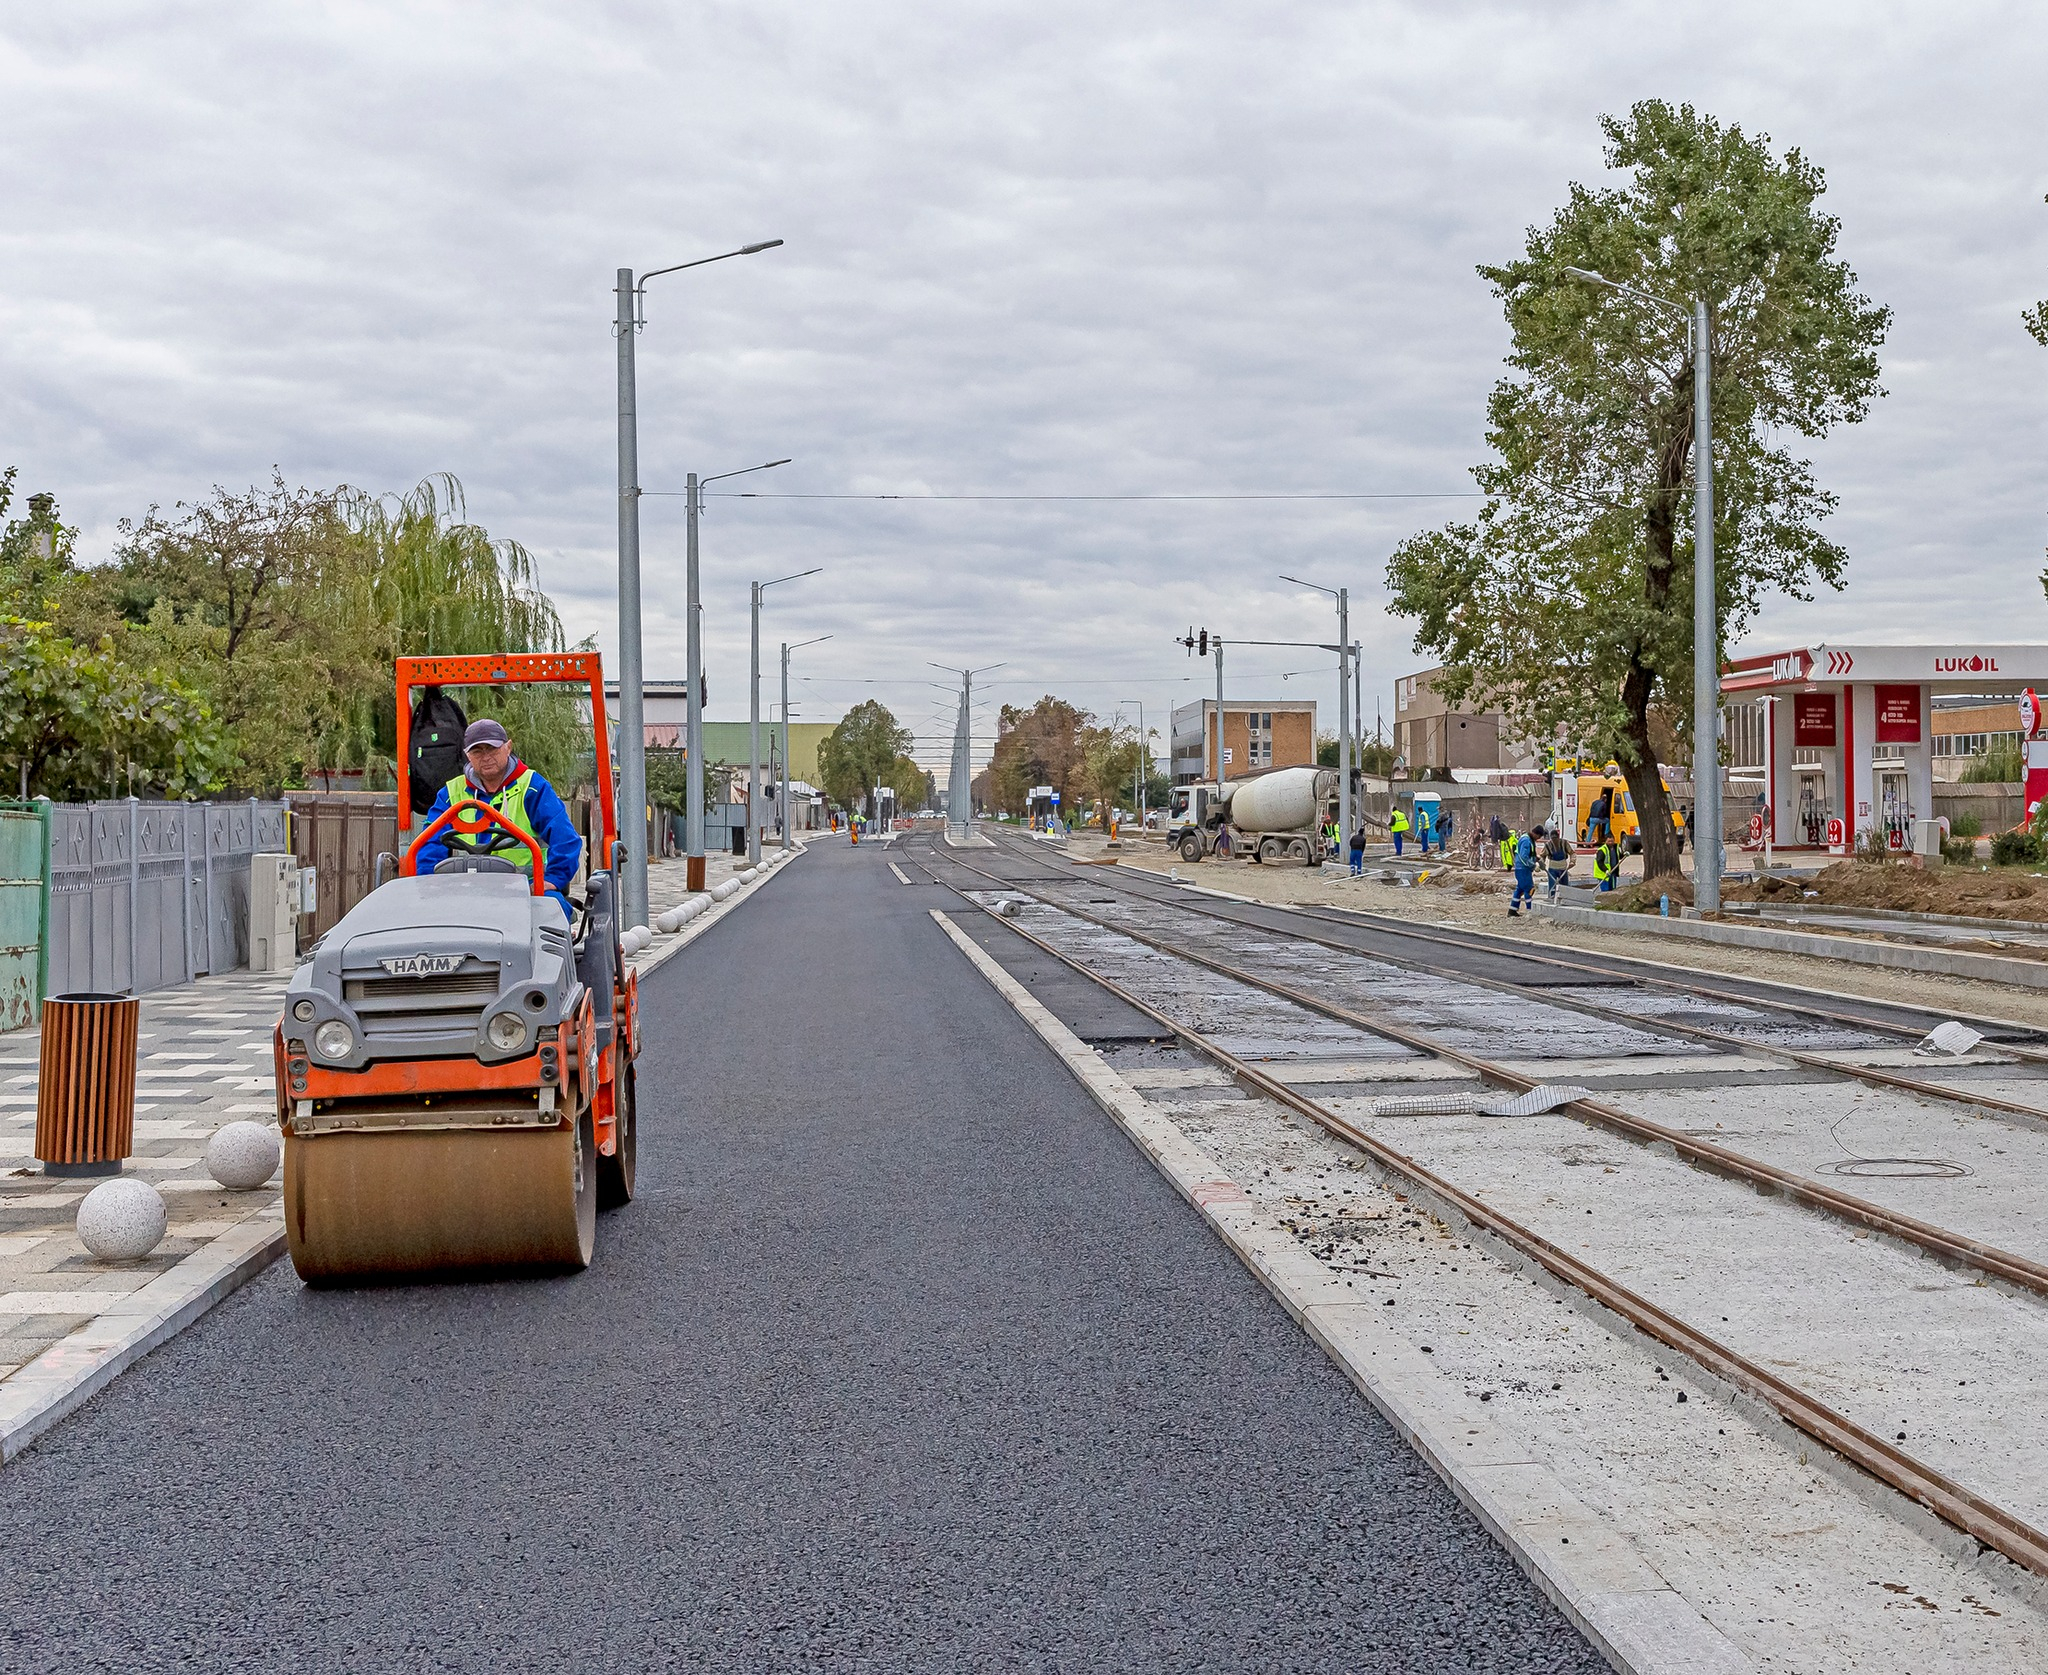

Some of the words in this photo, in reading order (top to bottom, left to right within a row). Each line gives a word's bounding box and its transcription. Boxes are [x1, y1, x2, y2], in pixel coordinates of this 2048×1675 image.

[1773, 652, 1803, 680] LUKOIL
[1935, 654, 1999, 672] LUKOIL
[1800, 718, 1806, 729] 2
[1881, 712, 1887, 723] 4
[394, 958, 451, 973] HAMM
